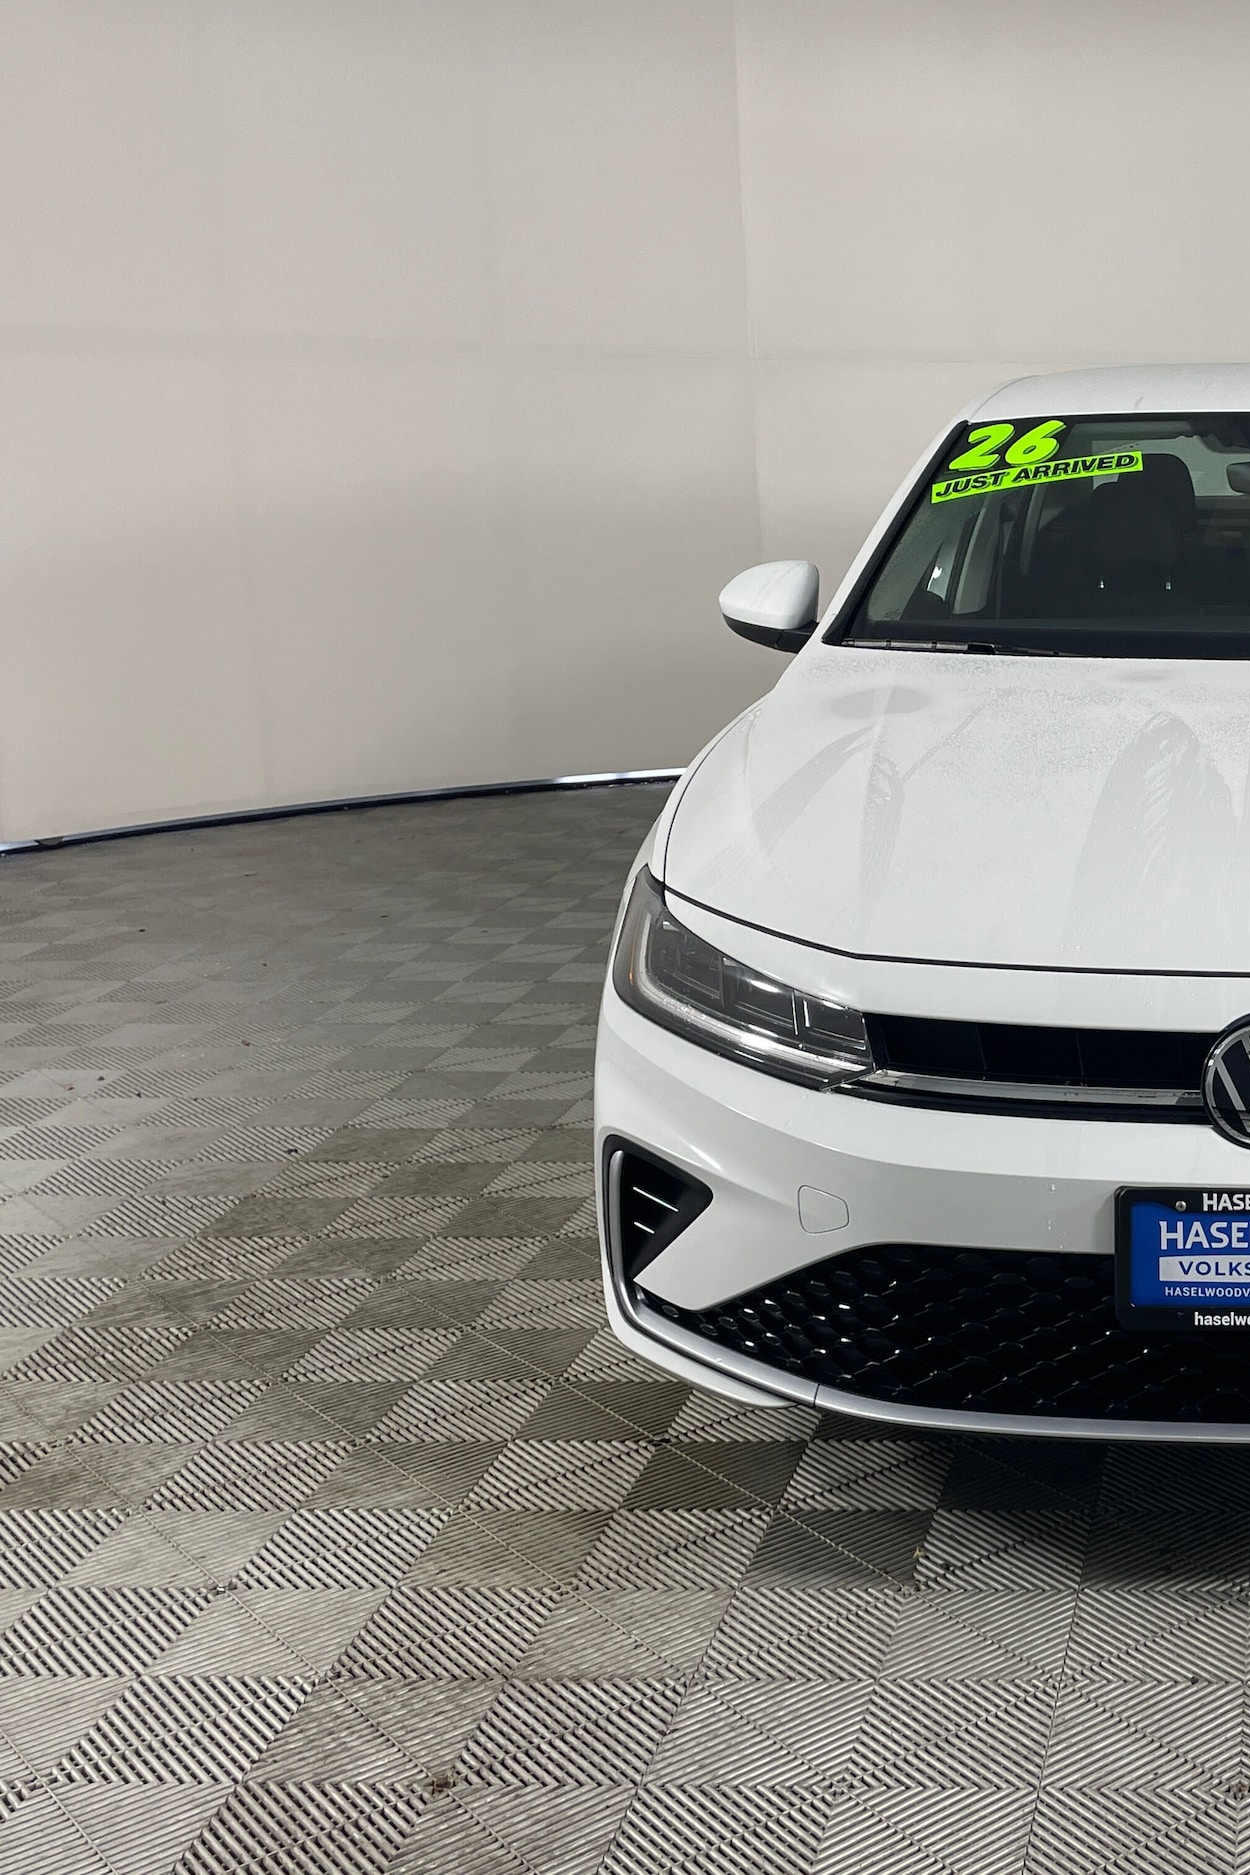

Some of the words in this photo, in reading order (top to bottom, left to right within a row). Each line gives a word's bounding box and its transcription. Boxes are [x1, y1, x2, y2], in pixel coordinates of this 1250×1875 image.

[949, 420, 1066, 471] 26
[936, 471, 1007, 497] JUST
[1012, 453, 1137, 483] ARRIVED
